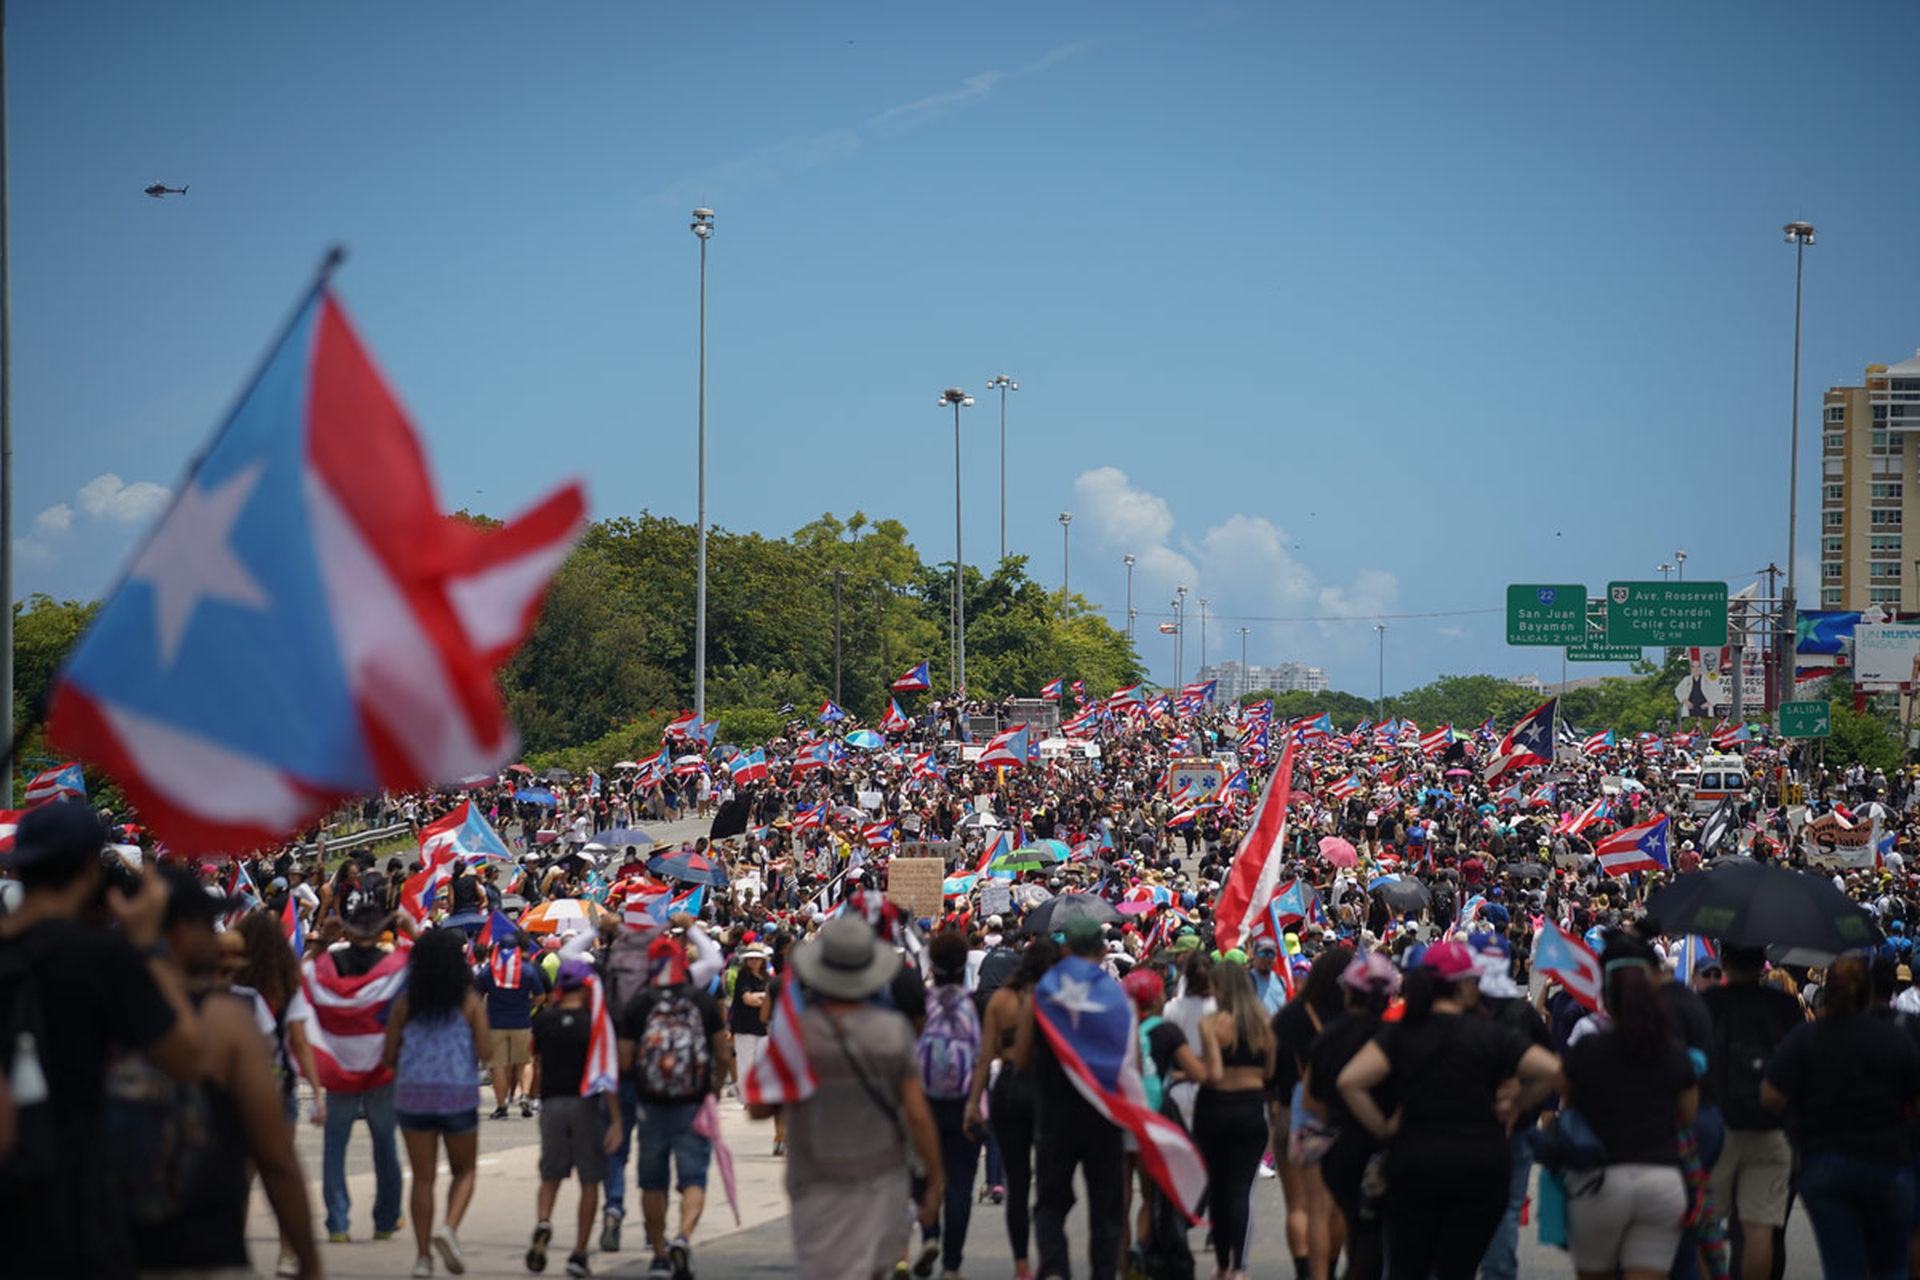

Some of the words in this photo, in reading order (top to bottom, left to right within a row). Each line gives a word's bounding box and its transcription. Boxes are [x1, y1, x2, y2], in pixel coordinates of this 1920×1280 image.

[1540, 590, 1554, 600] 22
[1635, 591, 1659, 600] Ave.
[1664, 591, 1724, 600] Roosevelt
[1518, 609, 1540, 618] San
[1546, 609, 1575, 618] Juan
[1623, 607, 1655, 617] Calle
[1660, 606, 1711, 617] Chardón
[1519, 621, 1574, 632] Bayamón
[1632, 619, 1663, 629] Calle
[1509, 634, 1548, 642] SALIDAS
[1553, 634, 1561, 642] 2
[1862, 640, 1908, 649] PAISAJE
[1786, 705, 1822, 715] SALIDA
[1796, 720, 1804, 730] 4
